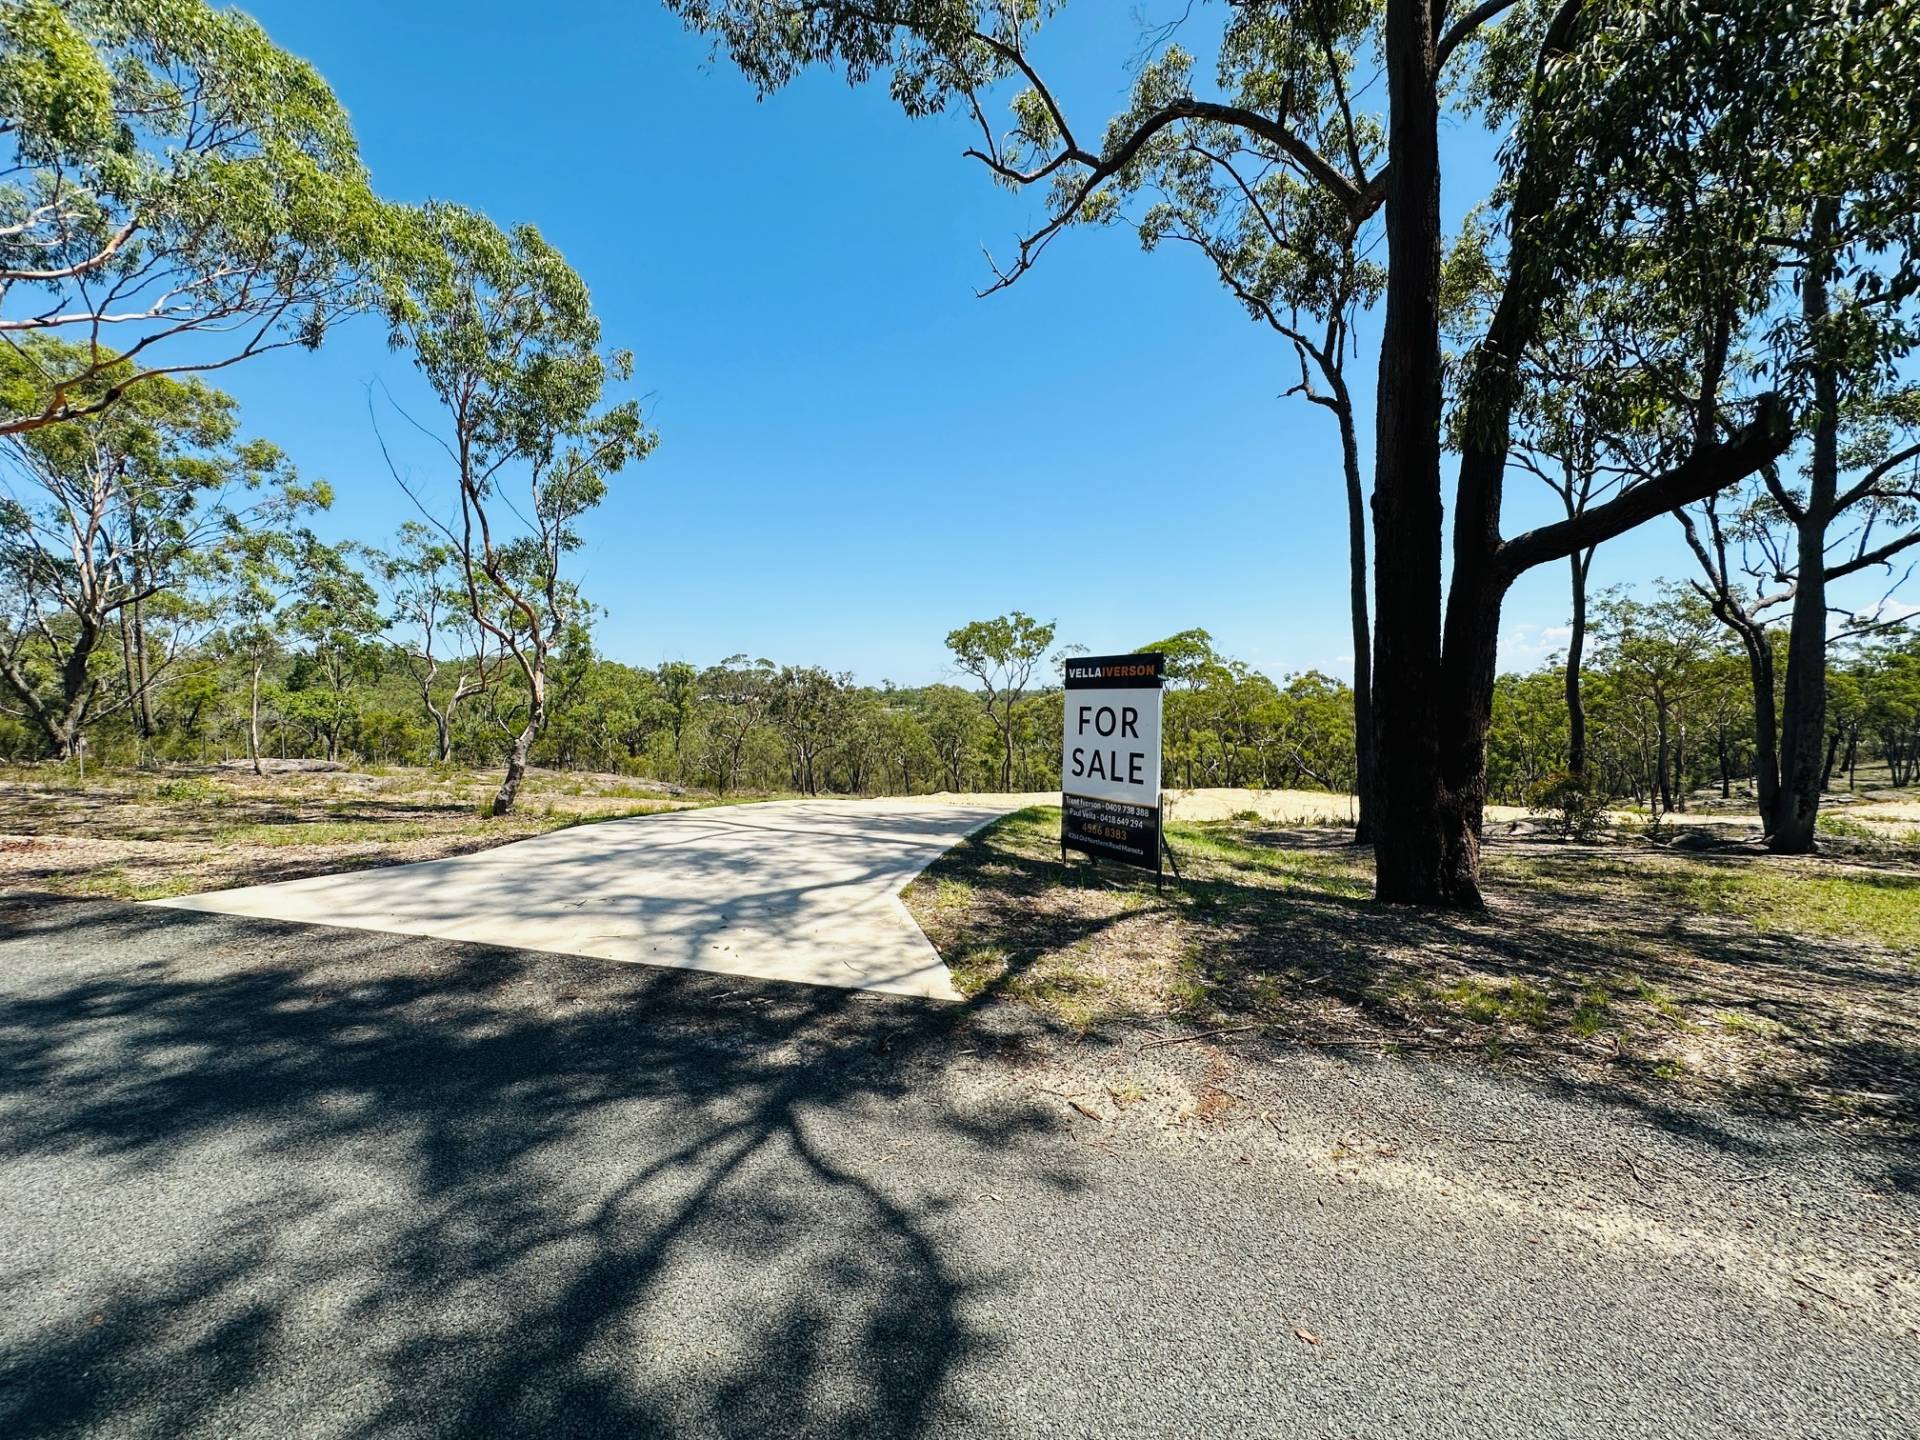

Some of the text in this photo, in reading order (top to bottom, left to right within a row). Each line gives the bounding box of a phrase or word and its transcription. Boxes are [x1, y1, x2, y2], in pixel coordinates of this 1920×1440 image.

[1078, 706, 1139, 738] FOR
[1071, 747, 1144, 785] SALE
[1069, 808, 1081, 817] Paul
[1081, 809, 1096, 820] Vella
[1099, 814, 1116, 824] 0418
[1116, 816, 1129, 826] 649
[1130, 819, 1143, 829] 294
[1080, 798, 1101, 809] Iverson
[1105, 802, 1121, 813] 0409
[1122, 805, 1135, 815] 738
